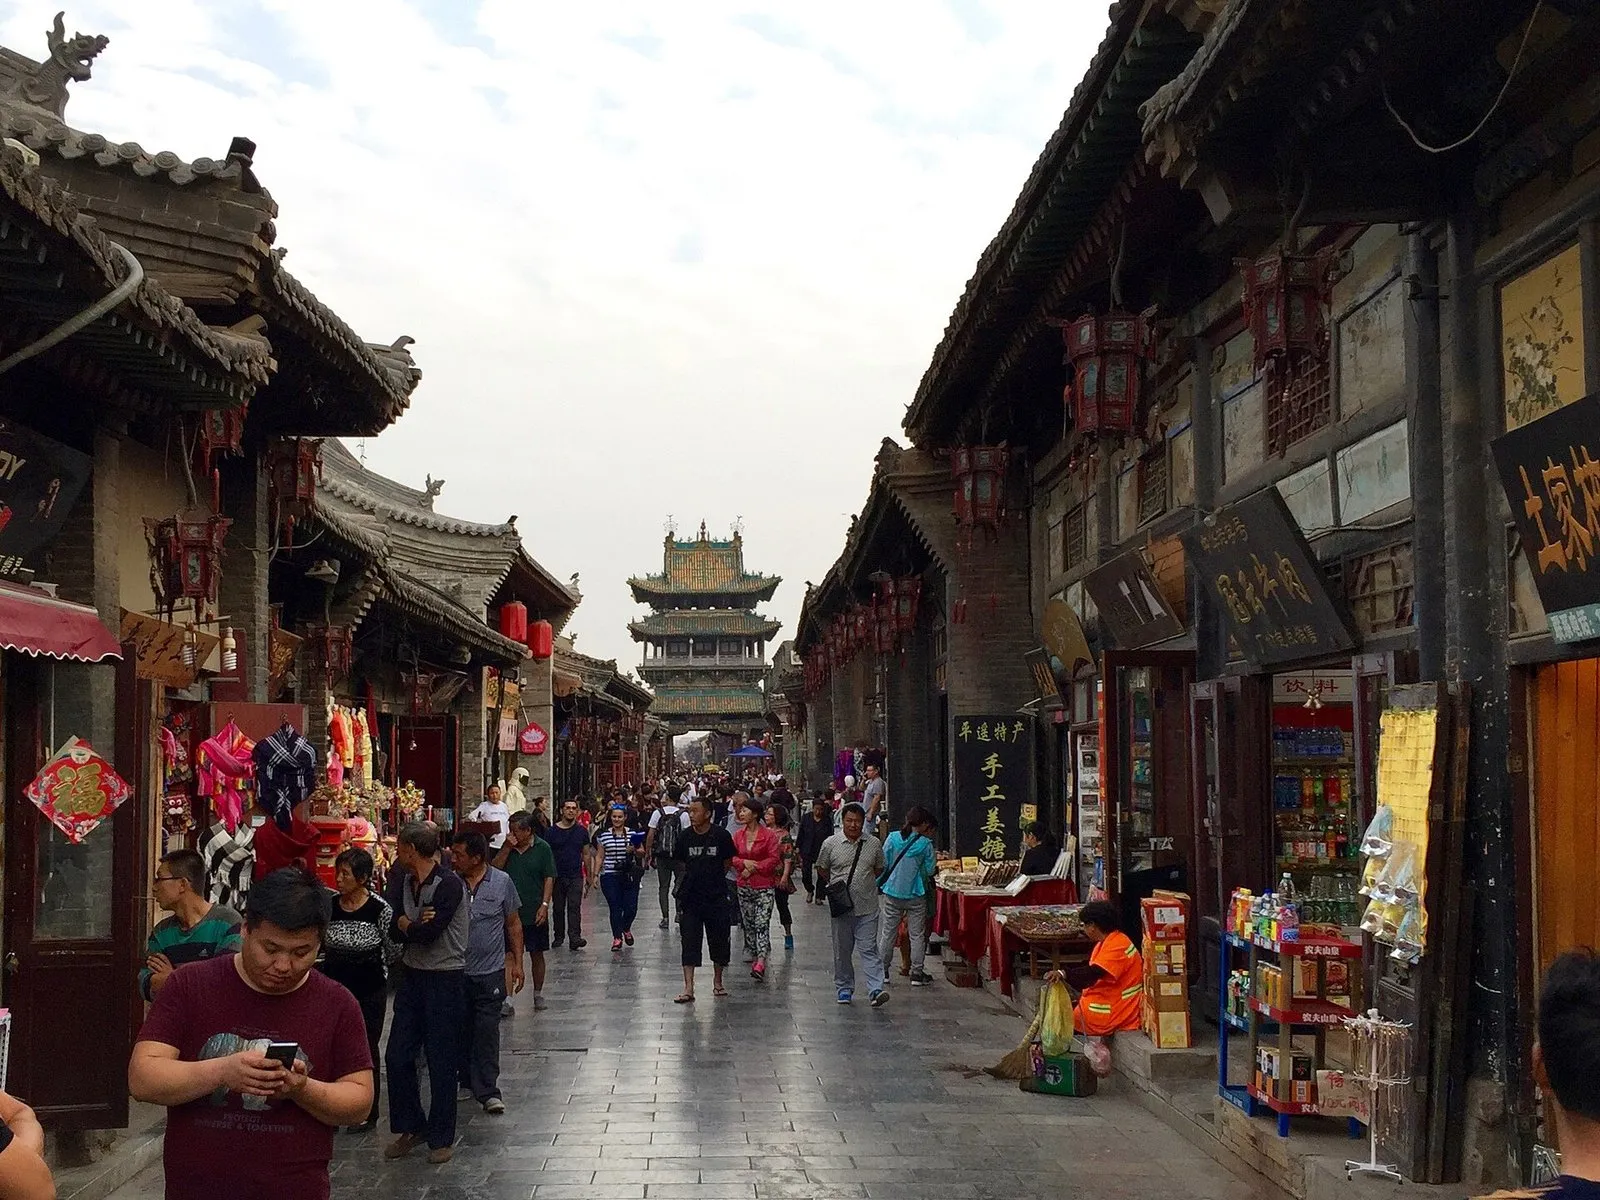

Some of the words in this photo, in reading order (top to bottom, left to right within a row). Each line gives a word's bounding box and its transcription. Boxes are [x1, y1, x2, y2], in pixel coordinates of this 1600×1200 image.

[1282, 678, 1339, 694] 饮料
[957, 720, 1025, 743] 平遥特产
[51, 762, 107, 817] 福
[979, 752, 1006, 859] 手工姜糖
[1304, 945, 1340, 956] 农夫山泉
[1302, 1013, 1338, 1023] 农夫山泉
